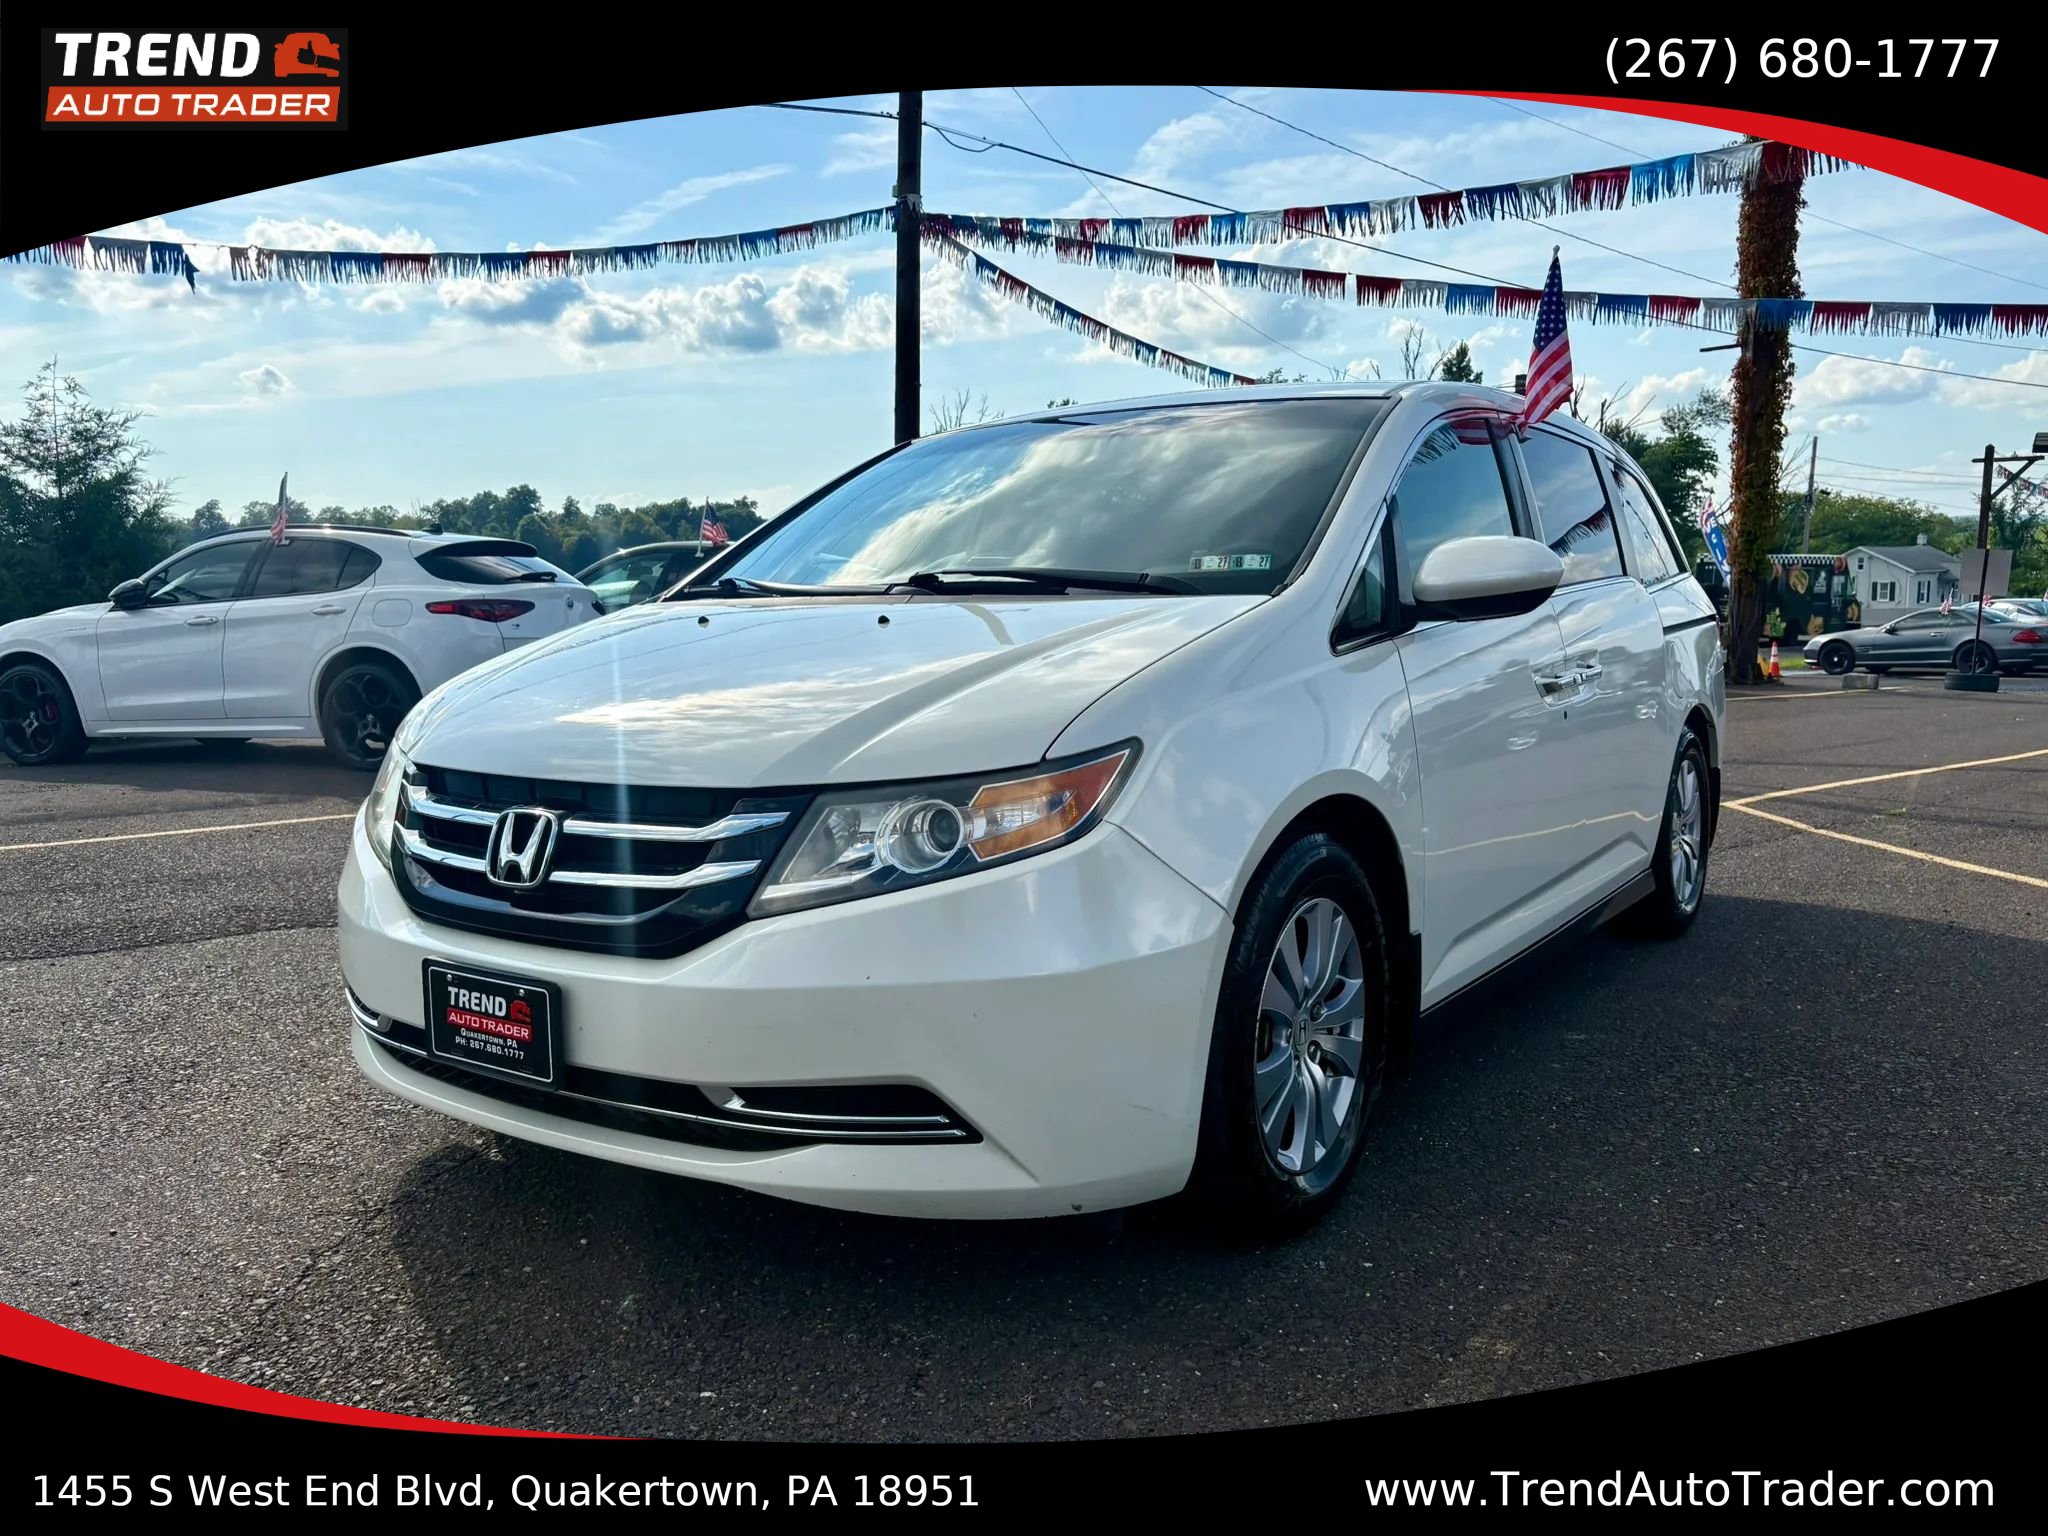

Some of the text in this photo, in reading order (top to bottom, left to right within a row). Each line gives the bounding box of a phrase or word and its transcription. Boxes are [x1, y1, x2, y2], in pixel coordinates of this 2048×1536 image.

[448, 986, 507, 1017] TREND
[449, 1012, 529, 1039] AUTO TRADER
[455, 1035, 525, 1060] PH: 267.680.1777
[507, 1038, 518, 1049] PA
